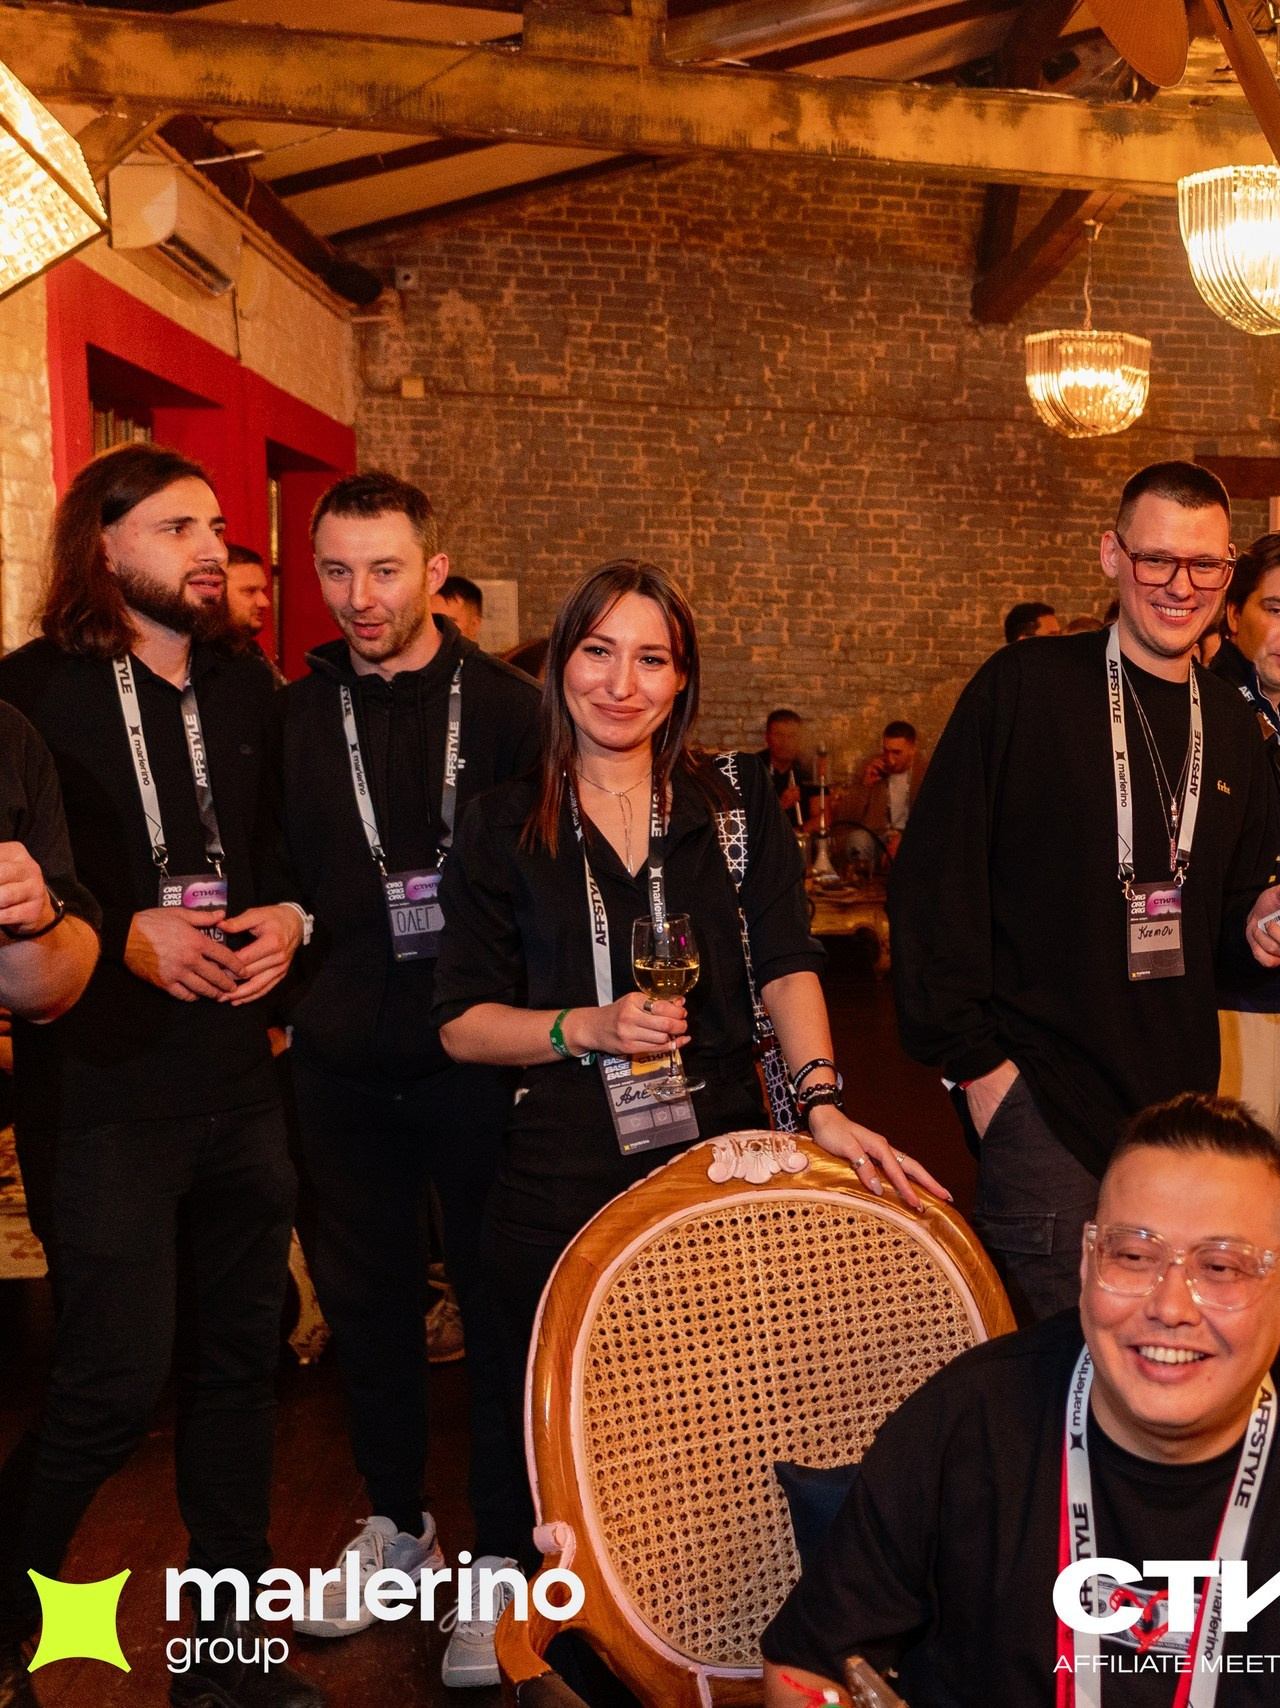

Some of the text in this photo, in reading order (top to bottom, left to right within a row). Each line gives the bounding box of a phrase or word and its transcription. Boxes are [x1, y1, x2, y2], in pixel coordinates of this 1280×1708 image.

[115, 657, 133, 695] TYLE
[1109, 659, 1122, 724] AFFSTYLE
[133, 739, 151, 787] marlerino
[185, 713, 208, 788] AFFSTYLE
[445, 720, 460, 787] AFFSTYLE
[1189, 729, 1202, 797] AFFSTYLE
[1117, 763, 1128, 808] marlerino
[604, 1061, 630, 1074] BASE
[606, 1068, 632, 1081] BASE
[1072, 1352, 1091, 1427] marlerino
[1234, 1386, 1273, 1509] AFFSTYLE
